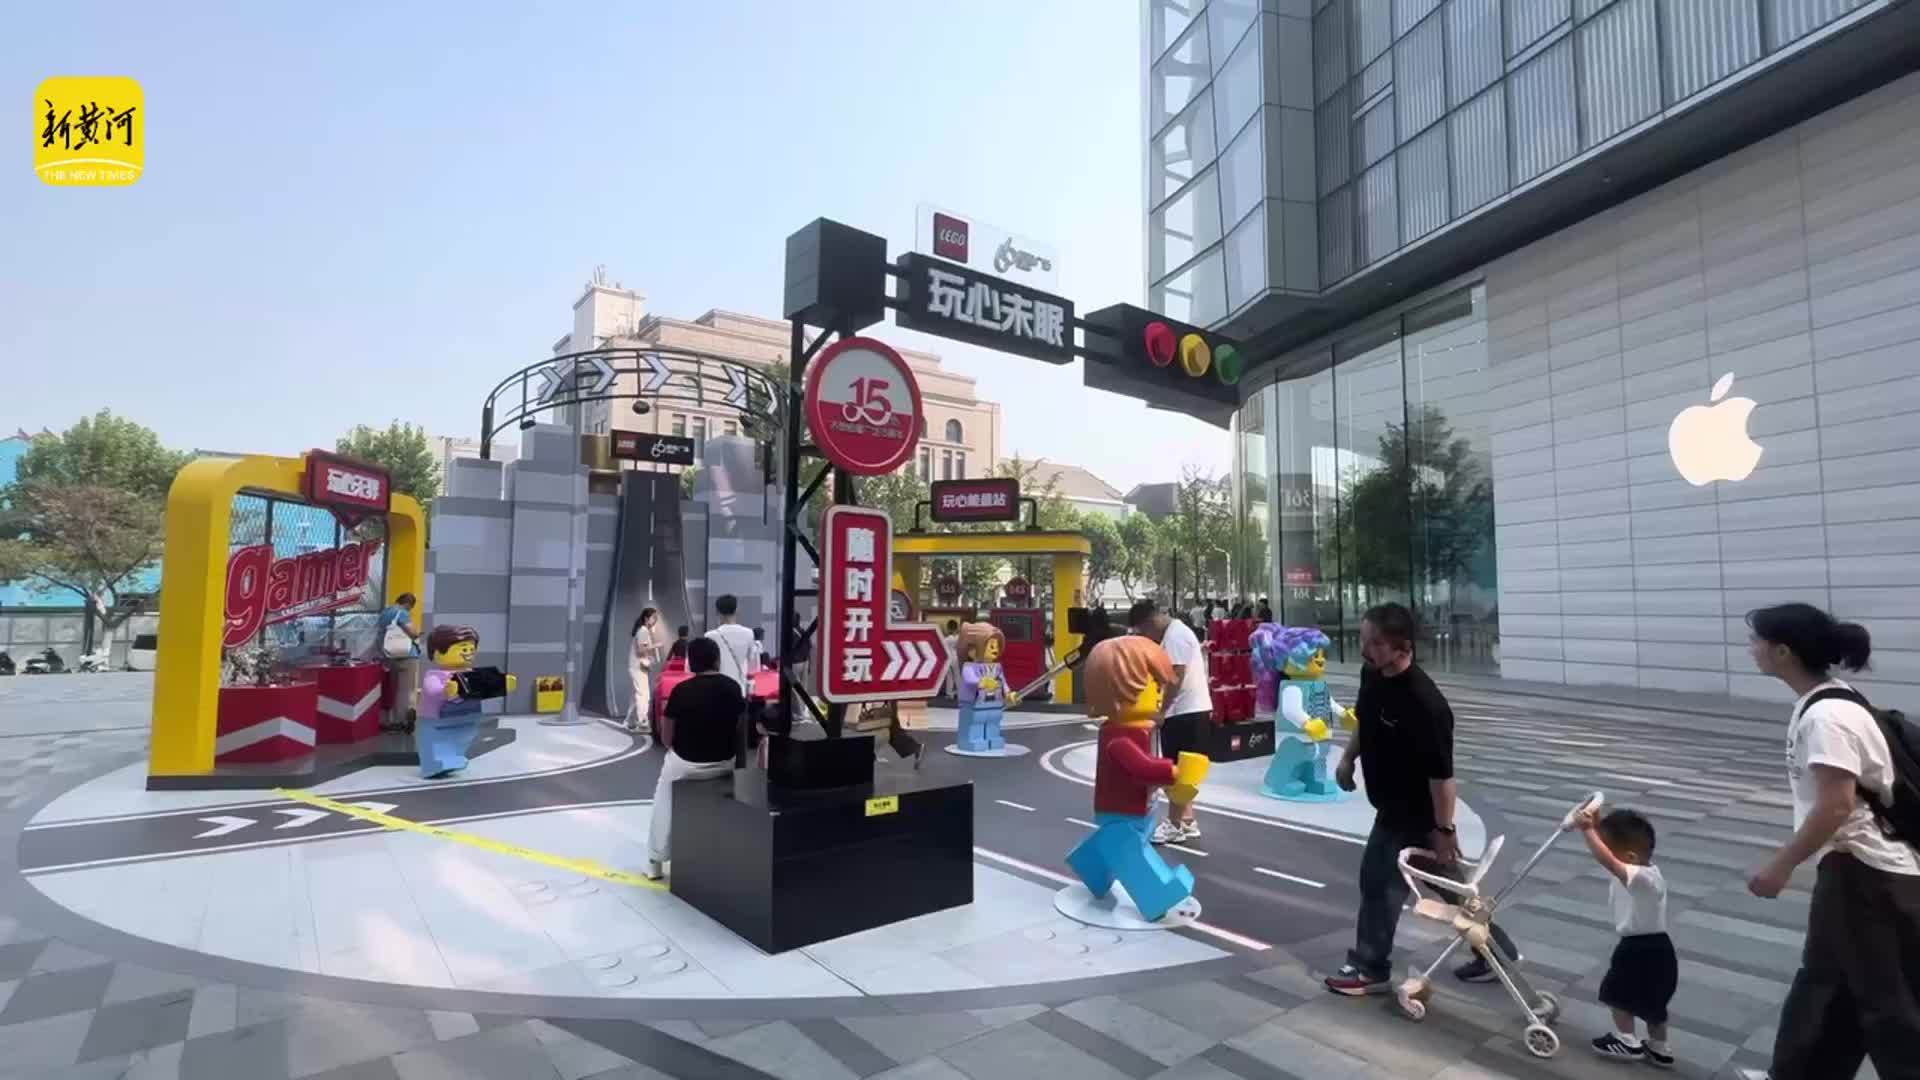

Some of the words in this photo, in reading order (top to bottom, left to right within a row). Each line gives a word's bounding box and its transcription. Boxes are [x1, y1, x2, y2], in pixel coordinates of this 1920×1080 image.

[940, 229, 966, 246] LEGO
[928, 268, 1064, 346] 玩心未眠
[223, 539, 384, 648] gamer
